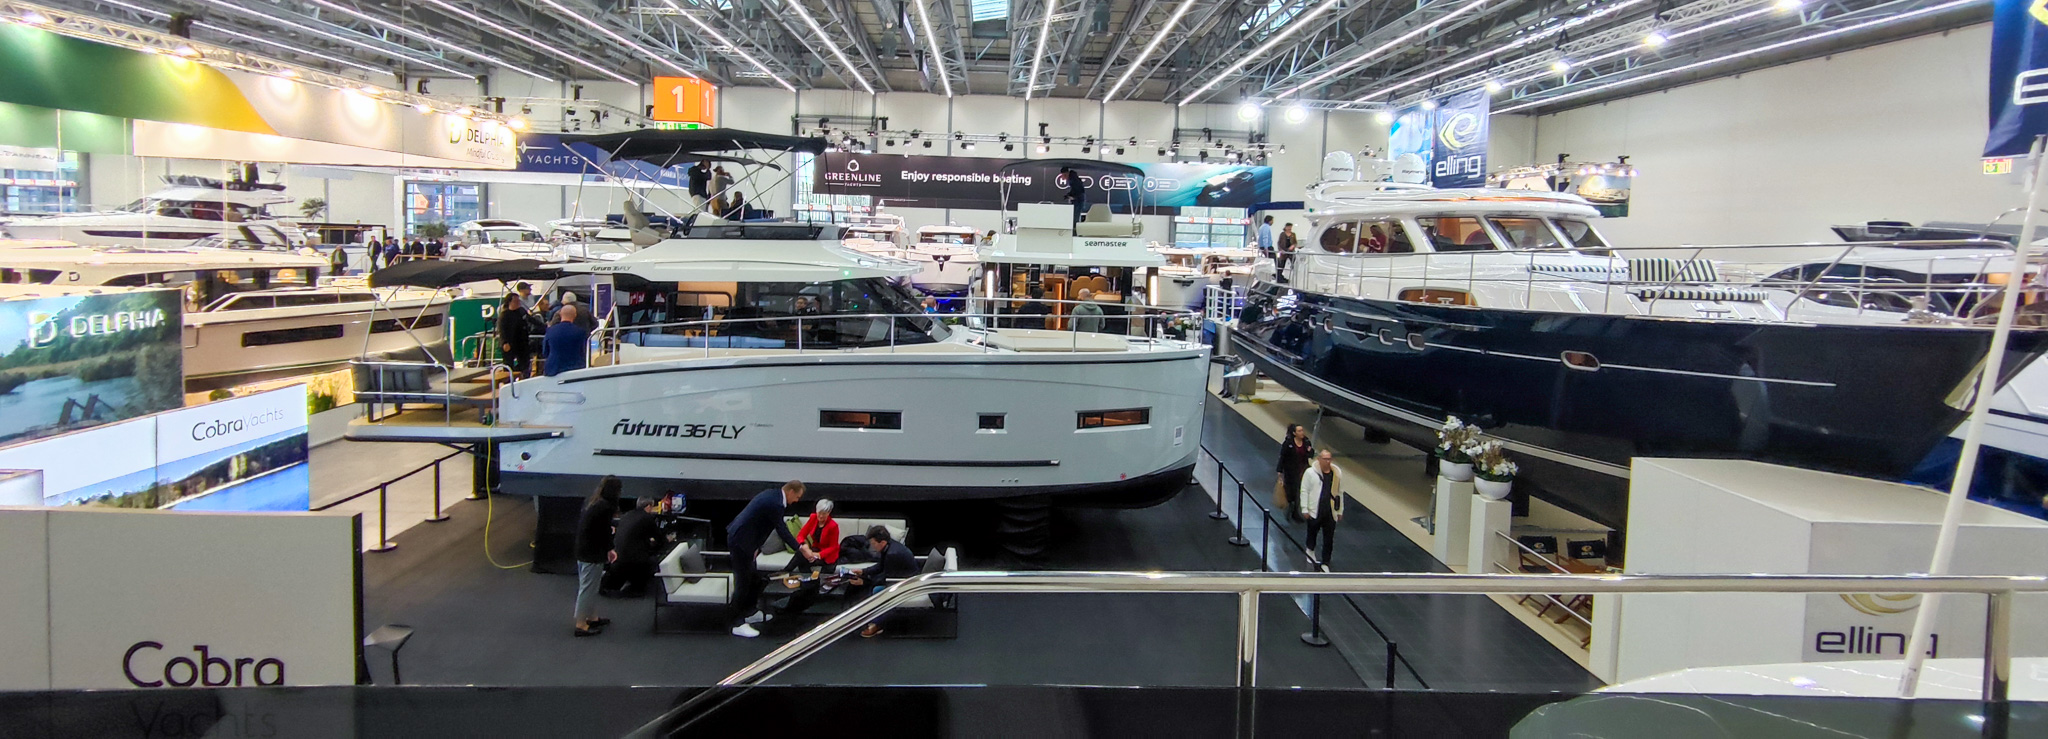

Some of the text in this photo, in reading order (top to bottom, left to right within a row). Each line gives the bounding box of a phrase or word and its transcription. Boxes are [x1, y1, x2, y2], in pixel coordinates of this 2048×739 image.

[671, 85, 684, 113] 1
[704, 90, 710, 117] 1
[466, 128, 506, 147] DELPHIA
[527, 155, 579, 165] YACHTS
[1435, 154, 1482, 178] elling
[824, 172, 881, 182] GREENLINE
[901, 170, 1032, 185] Enjoy responsible boating
[70, 308, 166, 338] DELPHIA
[122, 640, 285, 688] Cobra
